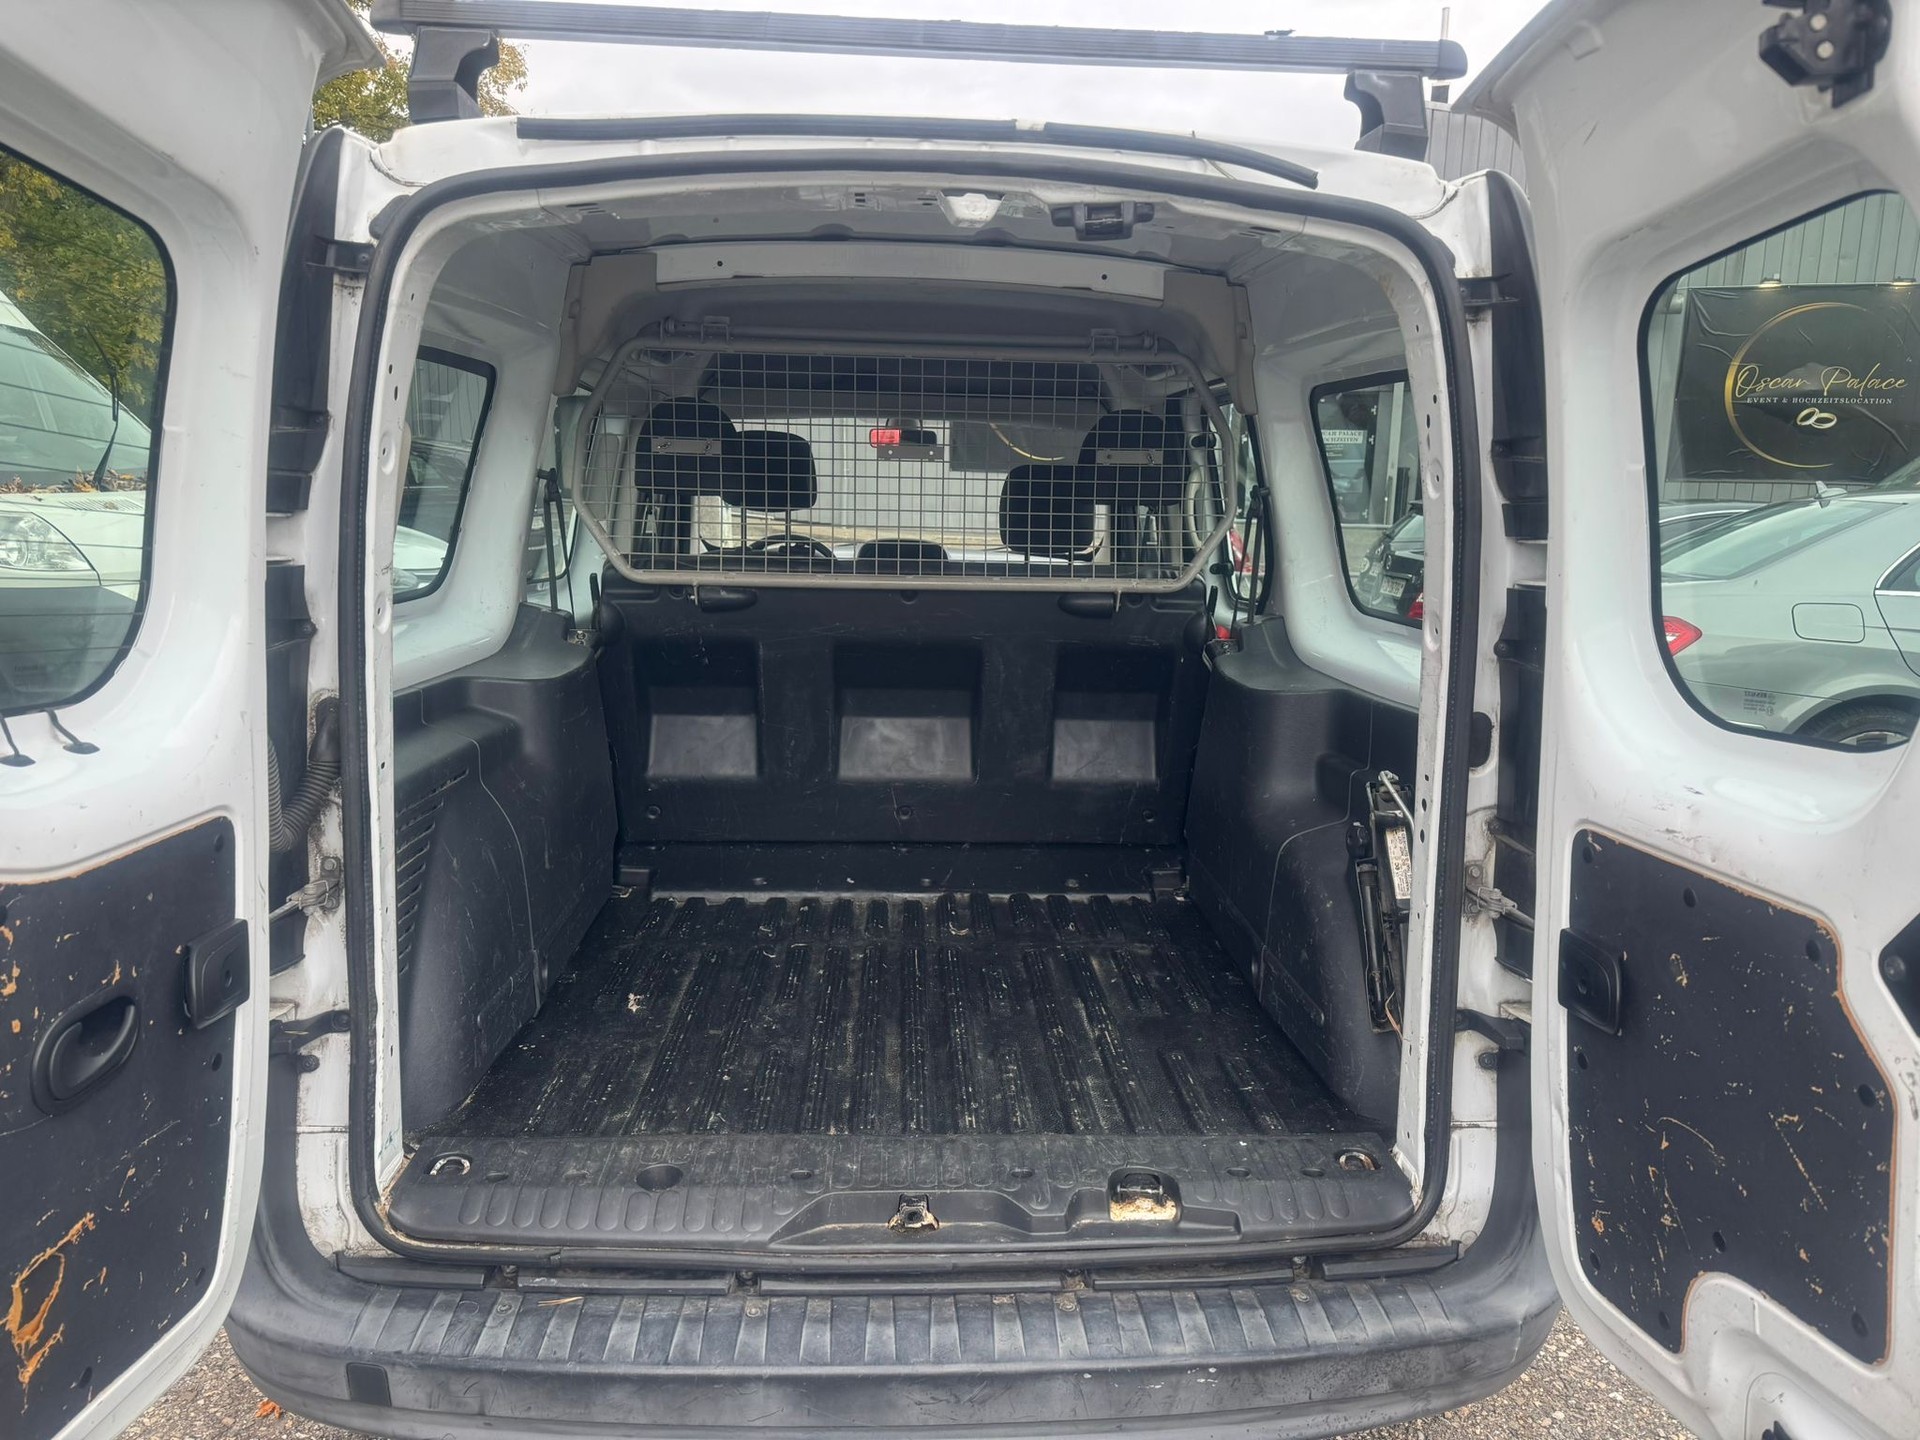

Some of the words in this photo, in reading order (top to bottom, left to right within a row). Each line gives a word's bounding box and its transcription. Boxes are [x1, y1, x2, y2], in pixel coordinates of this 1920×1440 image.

[1735, 365, 1811, 398] Oscar
[1820, 362, 1908, 397] Palace
[1792, 397, 1893, 405] HOCHZEITSLOCATION
